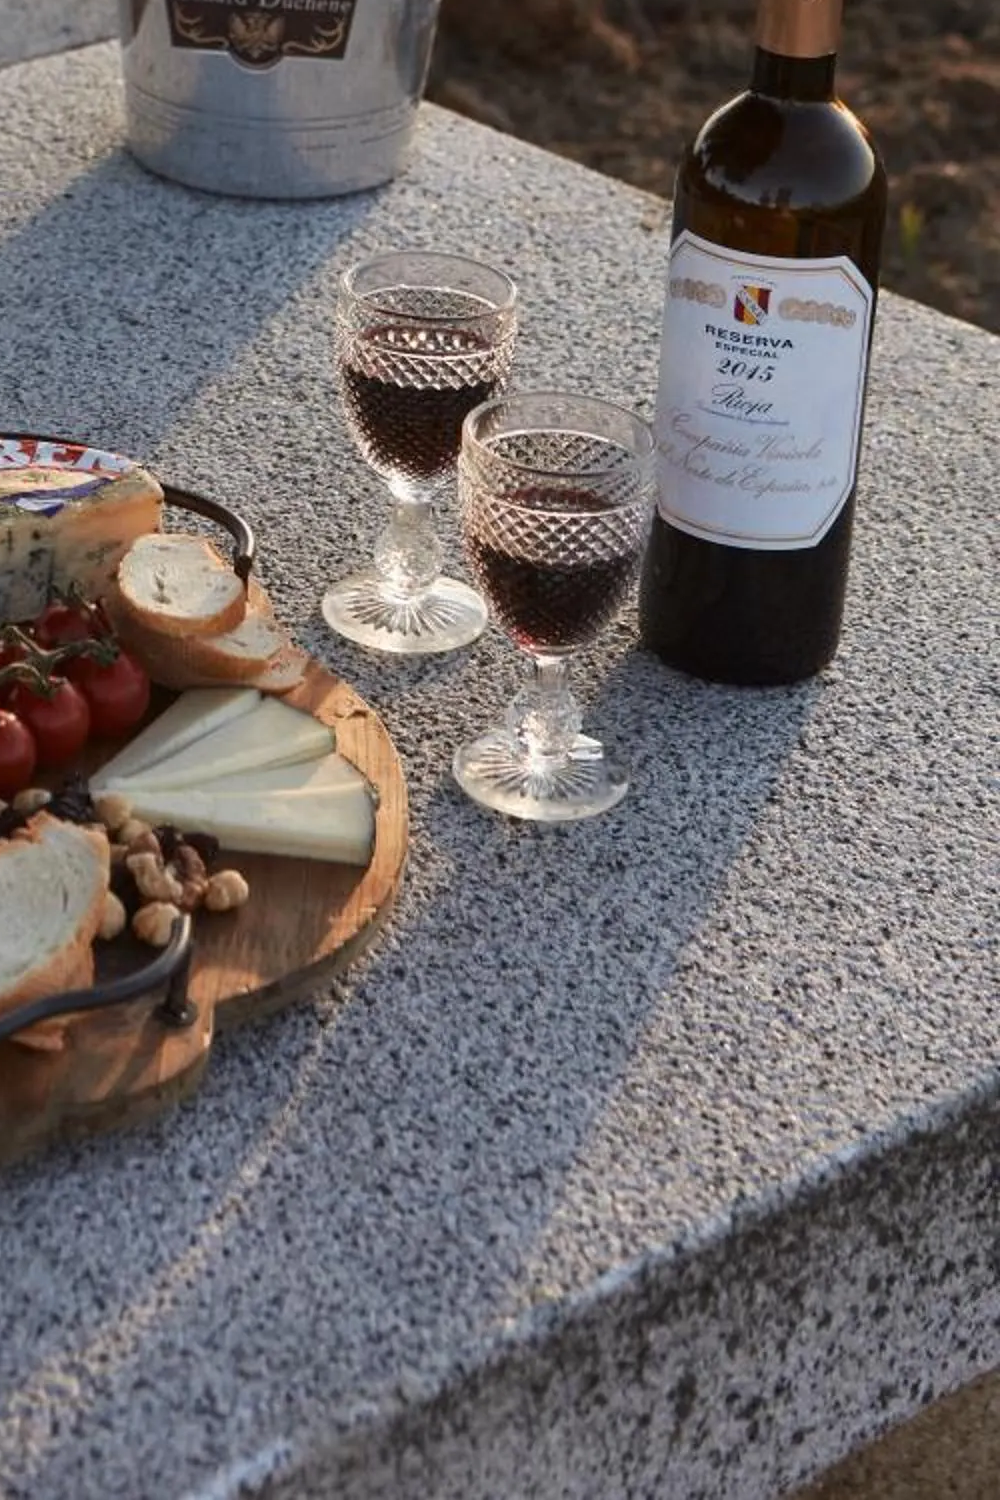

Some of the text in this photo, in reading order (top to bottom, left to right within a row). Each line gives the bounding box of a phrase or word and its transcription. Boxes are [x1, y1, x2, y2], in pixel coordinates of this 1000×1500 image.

[705, 323, 794, 349] RESERVA
[715, 341, 778, 359] ESPECIAL
[716, 357, 775, 383] 2015
[711, 383, 774, 415] Rioja
